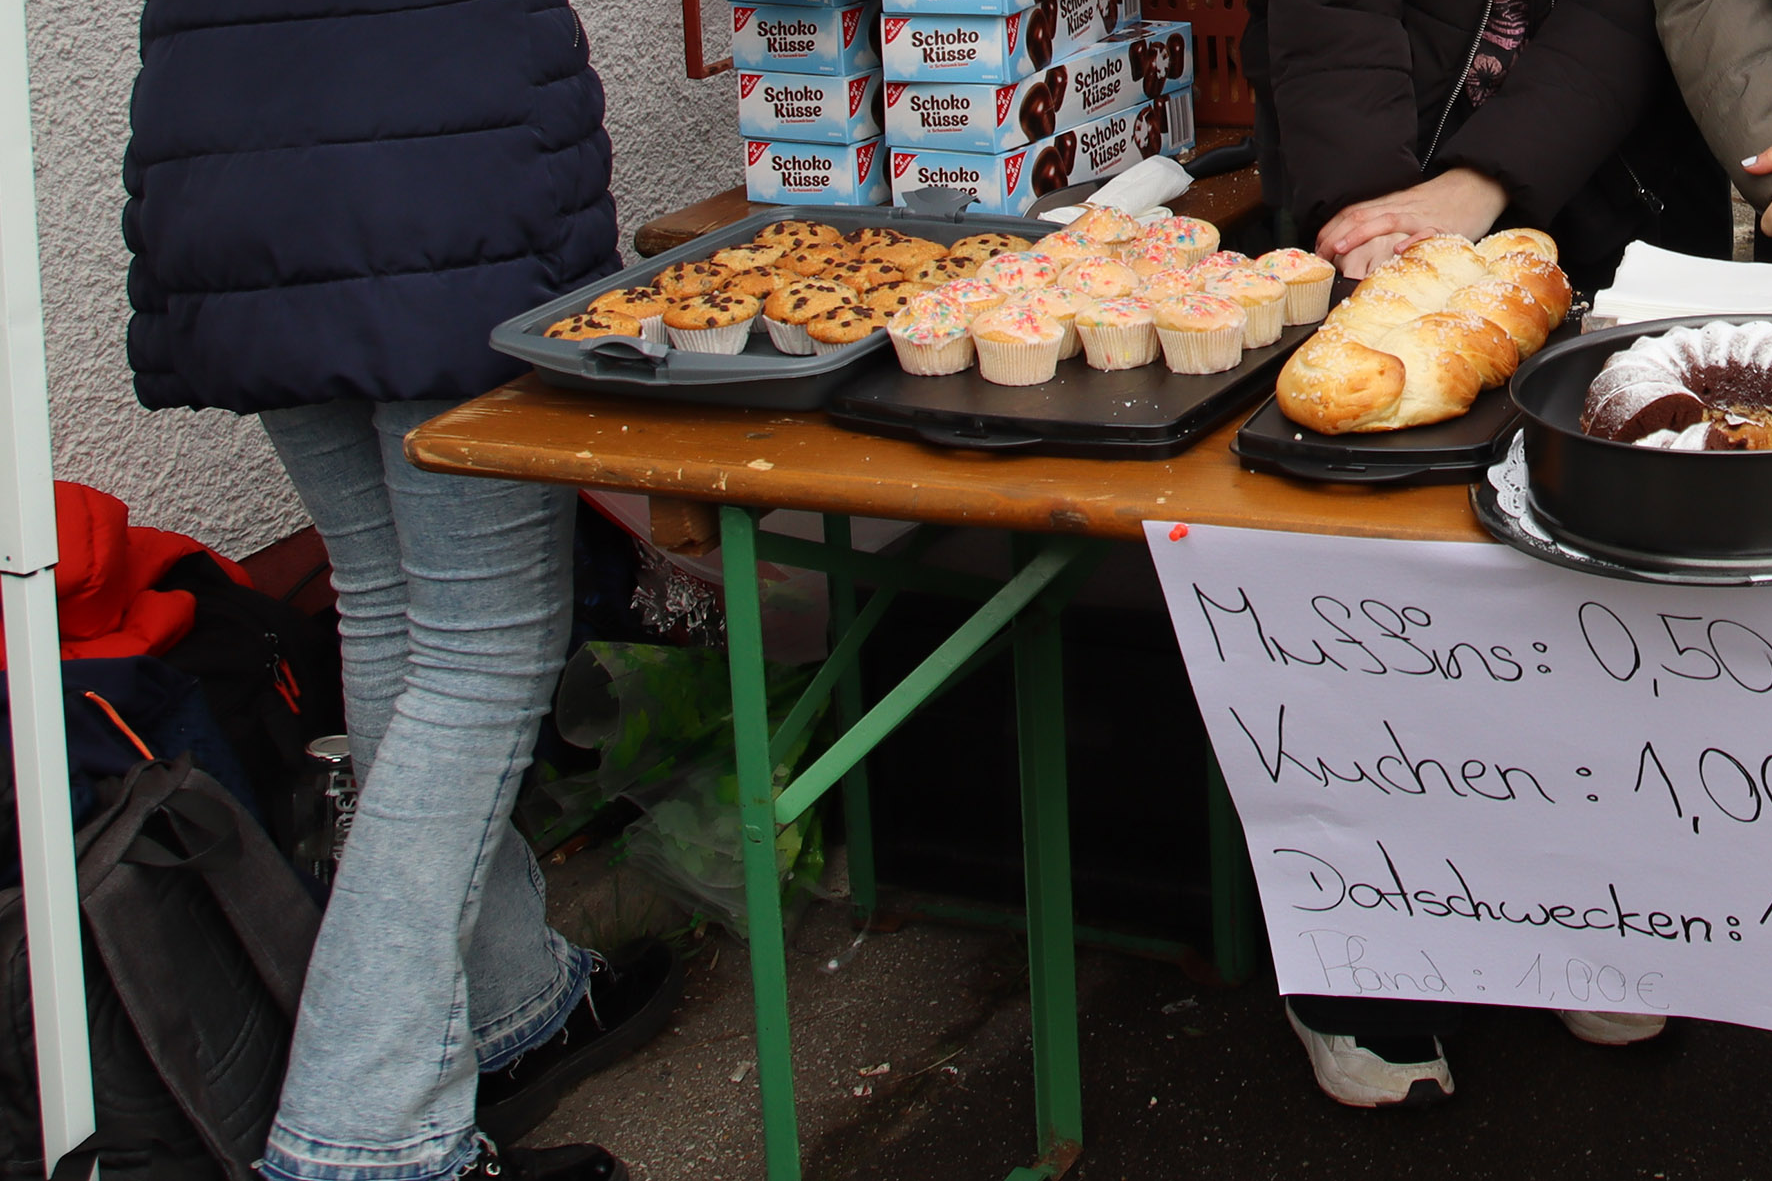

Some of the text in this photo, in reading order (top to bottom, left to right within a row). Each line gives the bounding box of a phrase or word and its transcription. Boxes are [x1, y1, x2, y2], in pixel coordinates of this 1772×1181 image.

[757, 20, 818, 37] Schoko
[1066, 6, 1094, 36] Küsse
[766, 37, 815, 53] Küsse
[911, 28, 979, 48] Schoko
[922, 47, 977, 64] Küsse
[1075, 58, 1122, 93] Schoko
[764, 85, 824, 103] Schoko
[910, 94, 970, 112] Schoko
[1082, 78, 1121, 110] Küsse
[774, 103, 822, 118] Küsse
[920, 112, 969, 128] Küsse
[1080, 118, 1127, 154] Schoko
[1089, 138, 1127, 170] Küsse
[772, 155, 832, 172] Schoko
[781, 171, 830, 188] Küsse
[918, 166, 980, 184] Schoko
